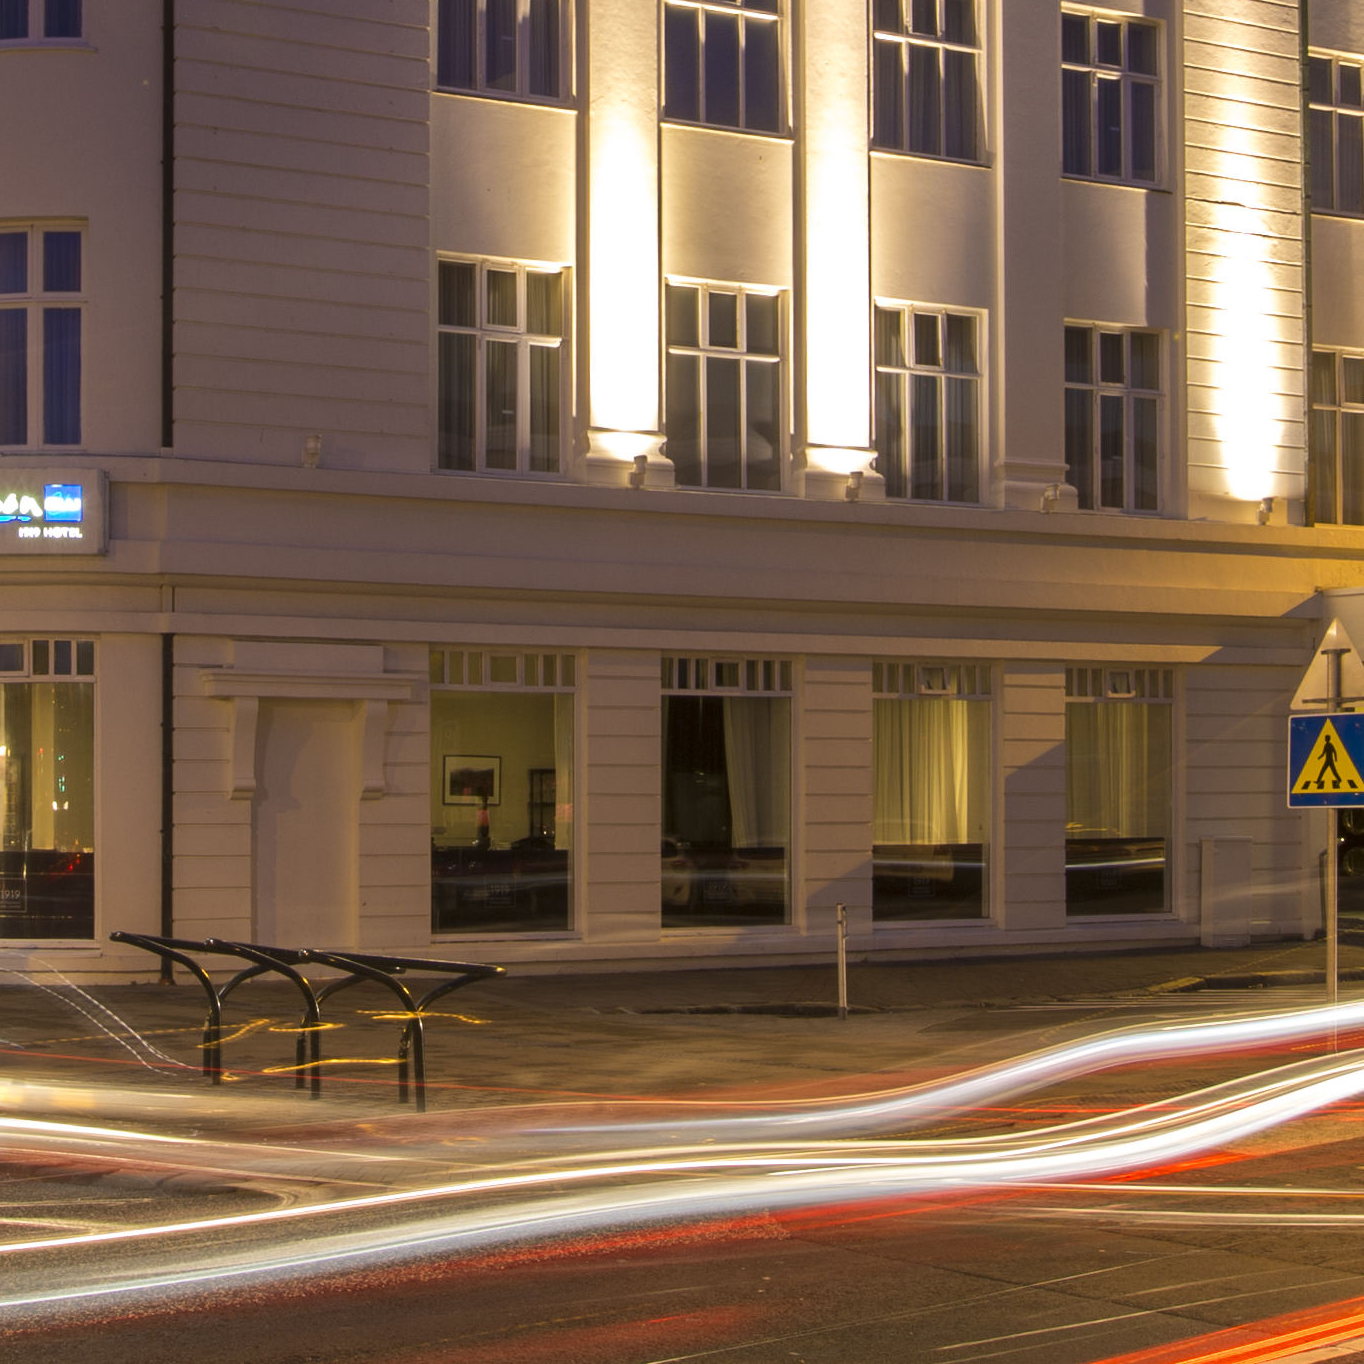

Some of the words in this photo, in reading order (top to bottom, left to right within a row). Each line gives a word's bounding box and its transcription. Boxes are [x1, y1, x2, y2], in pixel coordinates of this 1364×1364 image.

[18, 526, 41, 538] 1919
[43, 526, 83, 539] HOTEL
[0, 889, 21, 899] 1919
